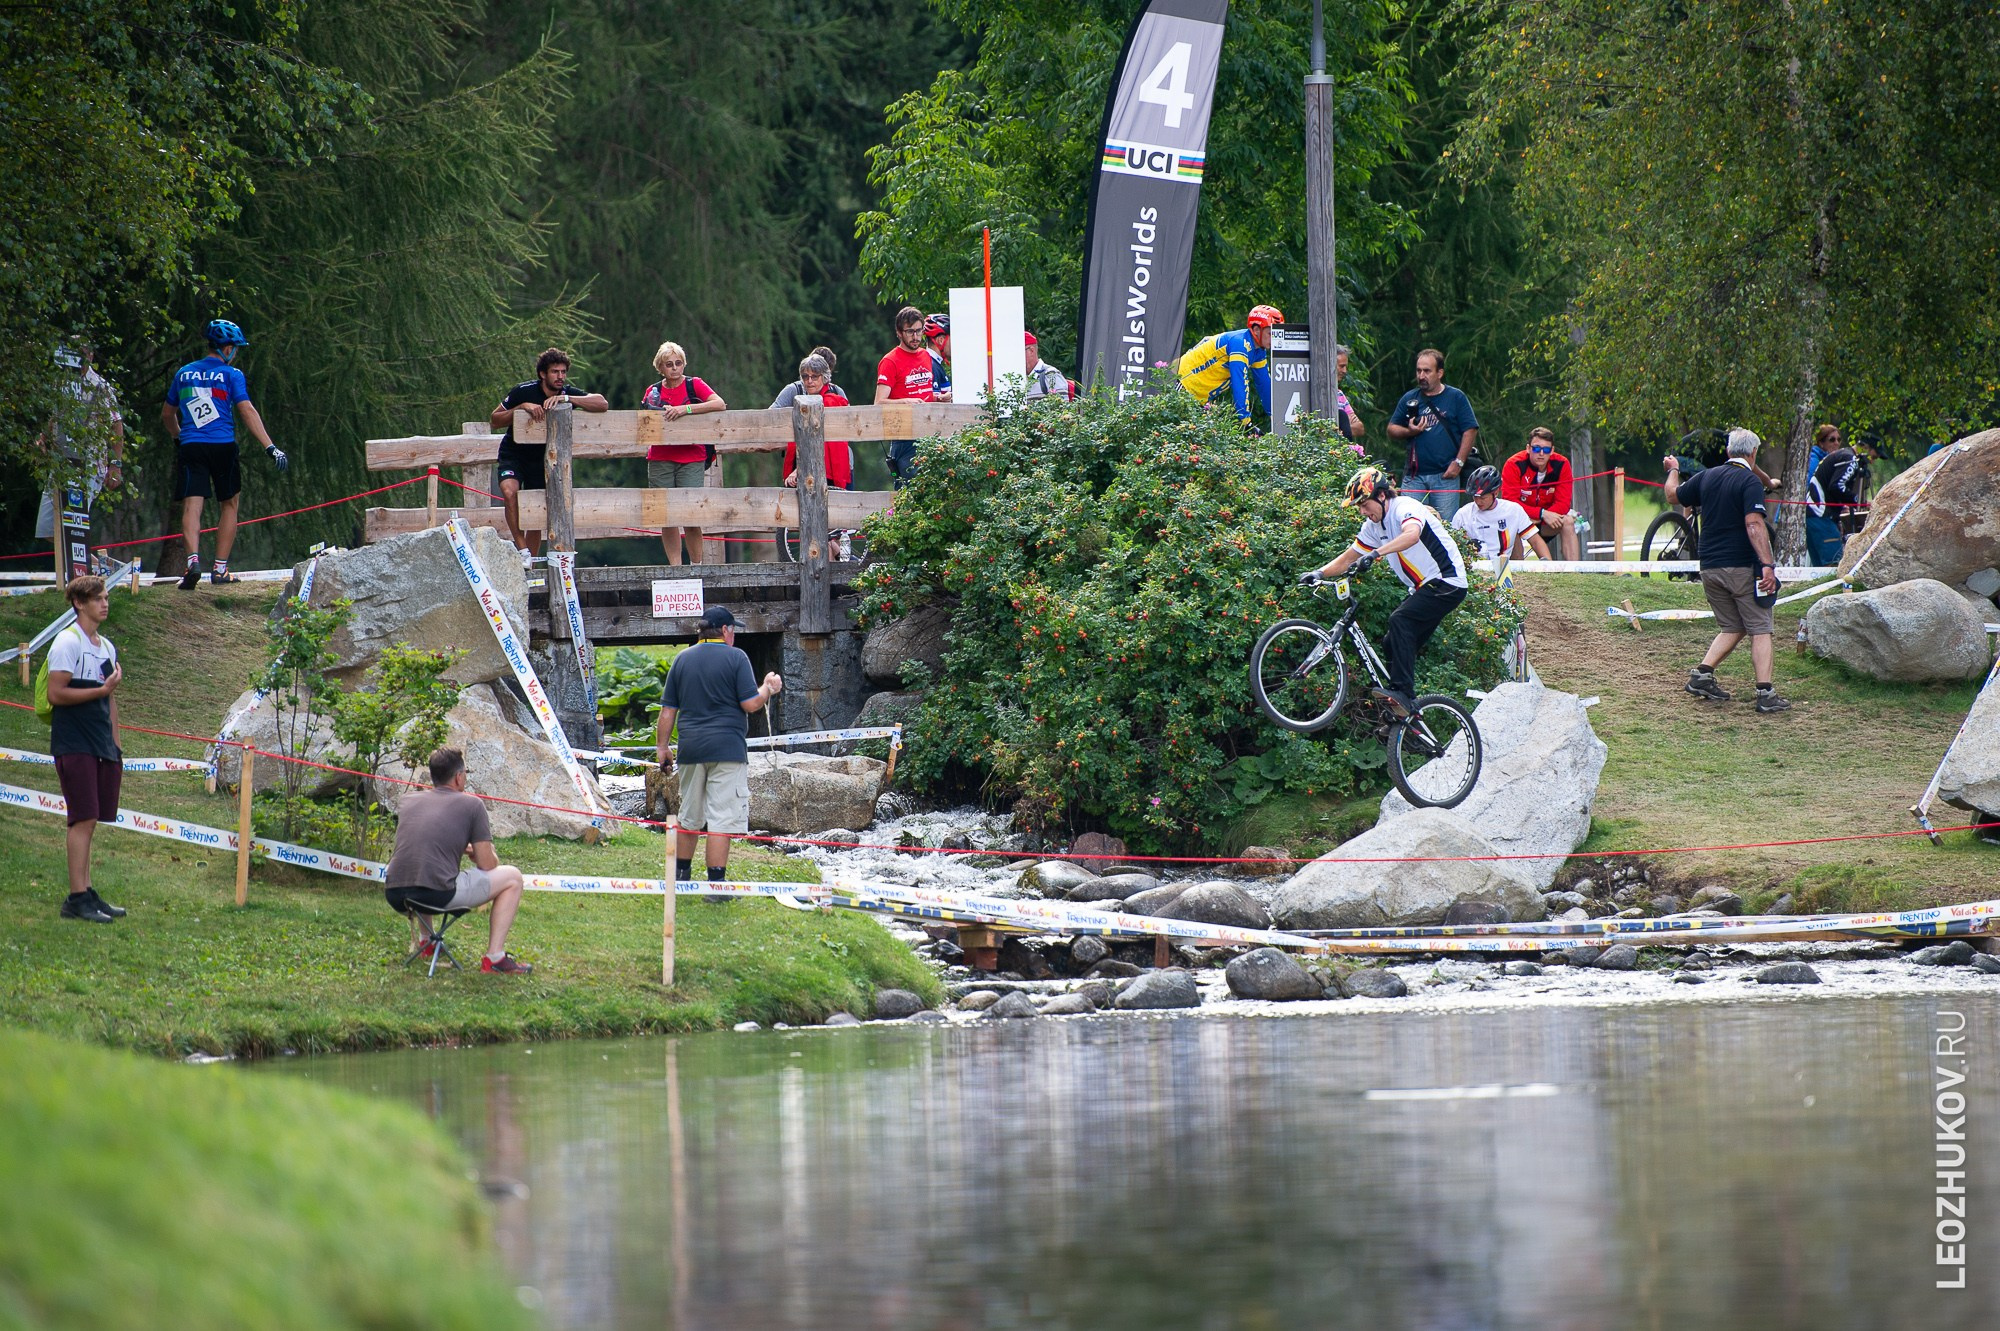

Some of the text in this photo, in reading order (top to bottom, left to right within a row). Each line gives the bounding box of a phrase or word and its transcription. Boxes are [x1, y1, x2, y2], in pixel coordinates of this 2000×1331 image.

[1139, 42, 1194, 128] 4
[1128, 148, 1173, 174] UCI
[1119, 206, 1157, 401] TrialsWorlds
[180, 371, 224, 382] ITALIA
[1275, 363, 1310, 382] START
[194, 403, 212, 420] 23
[73, 513, 82, 525] UCI
[76, 547, 84, 558] UCI
[654, 603, 702, 612] DI PESCA
[655, 593, 700, 603] BANDITA
[567, 599, 580, 638] TRENTINO
[456, 543, 480, 584] TRENTINO
[489, 609, 503, 632] Sole
[502, 634, 527, 675] TRENTINO
[550, 724, 573, 765] TRENTINO
[0, 791, 30, 802] ENTINO
[38, 796, 51, 808] Val
[133, 815, 146, 829] Val
[154, 821, 174, 834] Sole
[179, 826, 219, 843] TRENTINO
[228, 835, 239, 848] Va
[277, 846, 318, 864] TRENTINO
[329, 857, 342, 870] Val
[350, 862, 372, 876] Sole
[965, 899, 1007, 912] TRENTINO
[1066, 911, 1108, 925] TRENTINO
[1167, 923, 1208, 937] TRENTINO
[1950, 908, 1964, 917] Val
[1972, 904, 1994, 914] Sole
